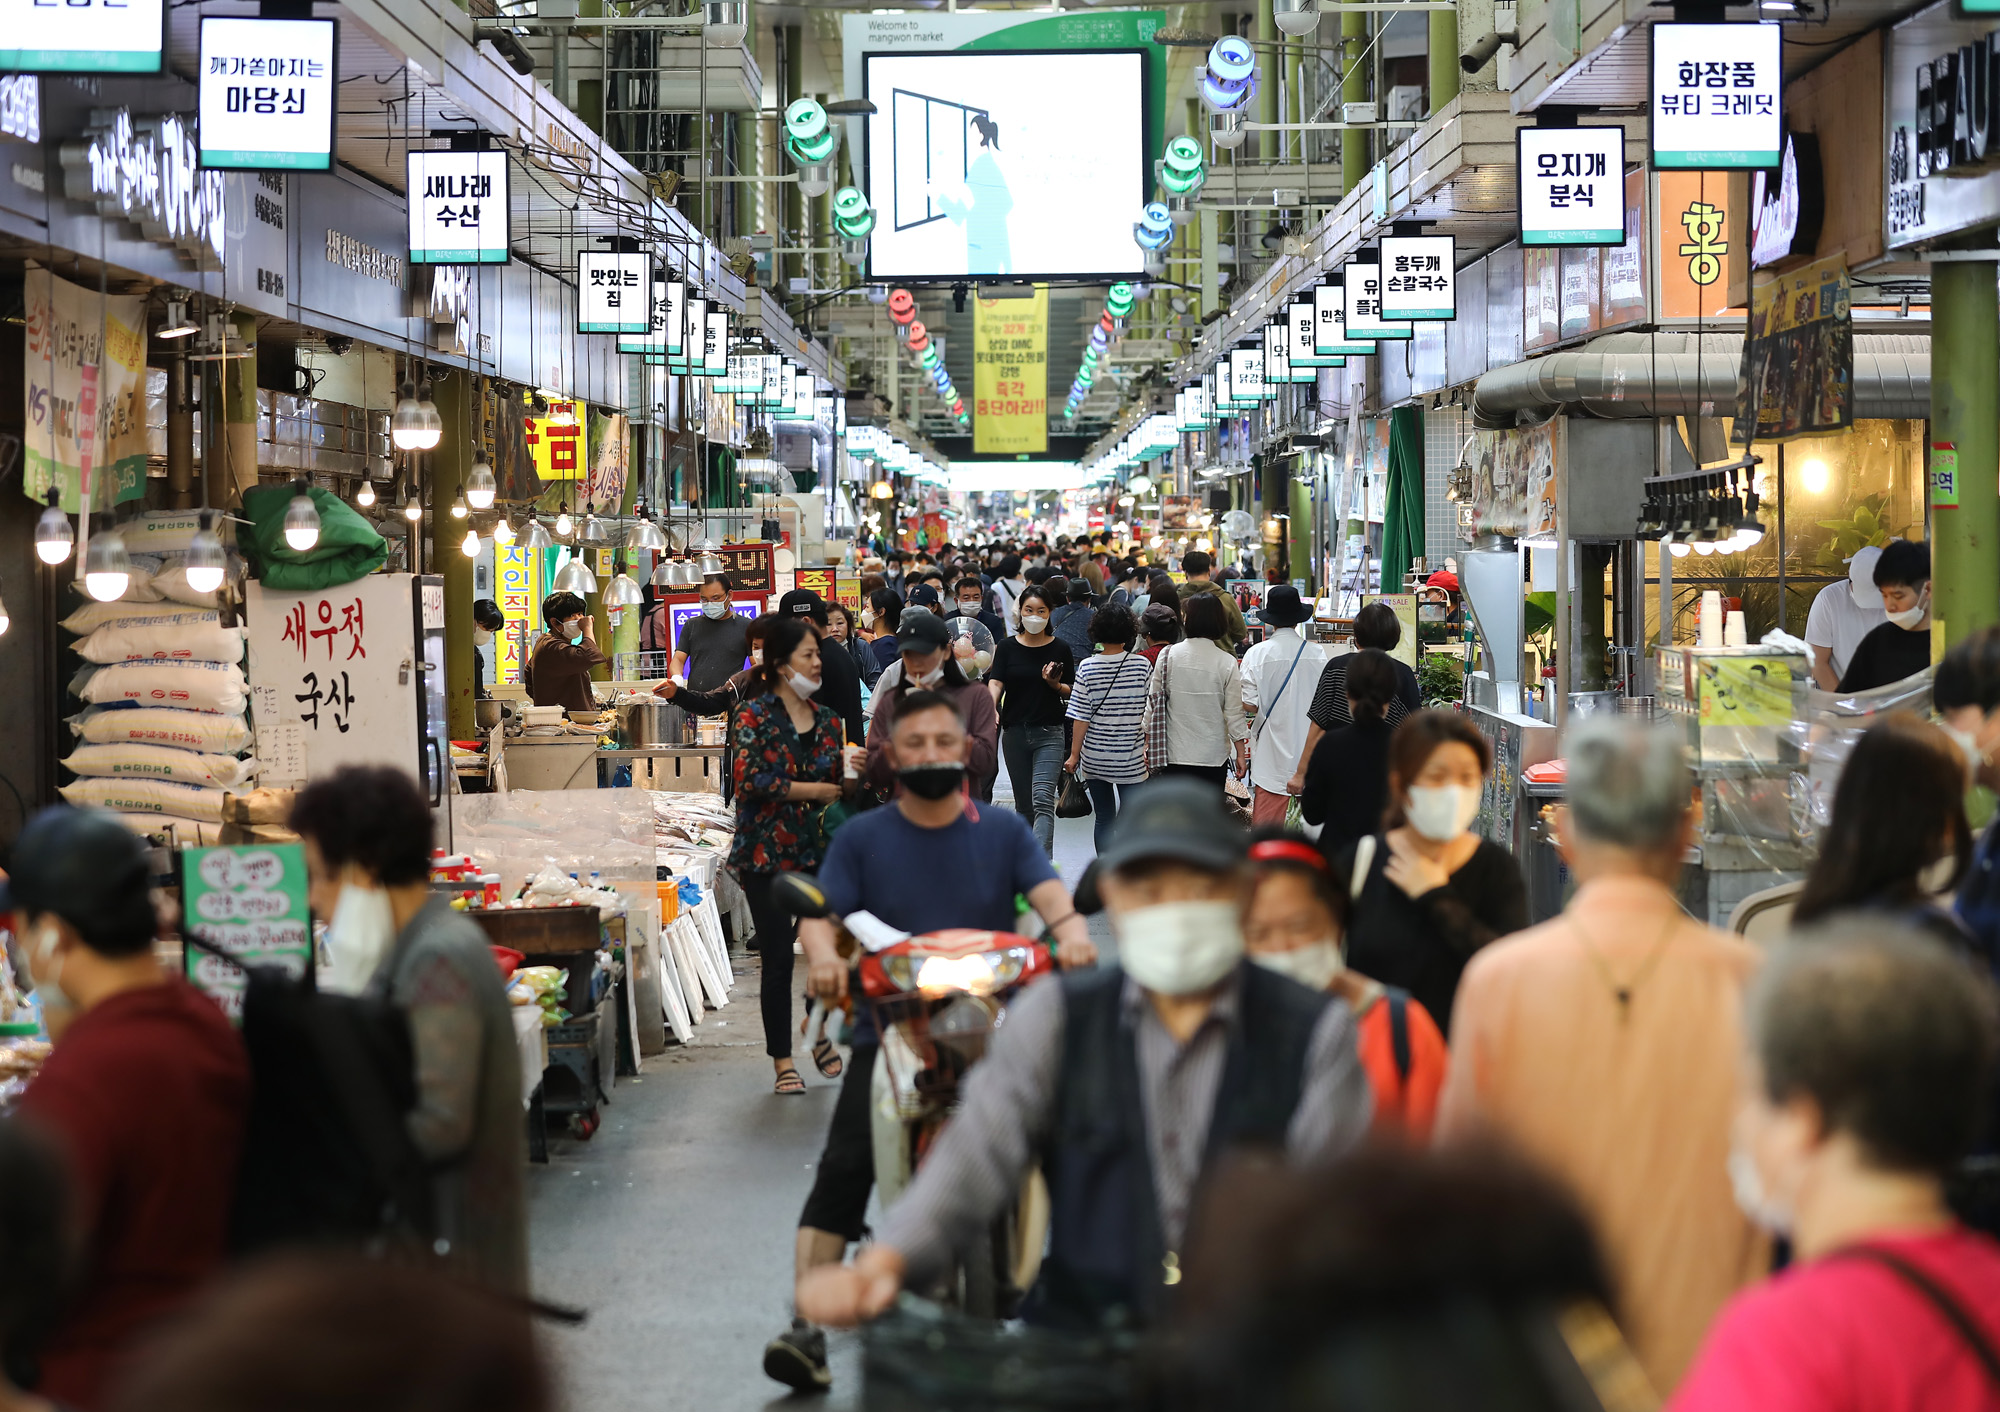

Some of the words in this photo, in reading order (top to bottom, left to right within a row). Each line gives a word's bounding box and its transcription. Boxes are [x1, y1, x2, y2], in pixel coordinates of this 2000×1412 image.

[868, 20, 907, 31] Welcome
[909, 21, 919, 30] to
[868, 33, 912, 45] mangwon
[914, 31, 944, 42] market
[210, 56, 323, 78] 깨가쏟아지는
[1679, 60, 1756, 88] 화장품
[227, 86, 306, 115] 마당쇠
[1661, 94, 1702, 116] 뷰티
[1711, 94, 1773, 116] 크레딧
[1537, 153, 1606, 178] 오지개
[424, 174, 491, 199] 새나래
[1549, 183, 1594, 208] 분식
[436, 204, 481, 228] 수산
[1679, 201, 1729, 285] 홍
[1394, 255, 1441, 272] 홍두깨
[590, 267, 639, 287] 맛있는
[1387, 275, 1448, 292] 손칼국수
[1363, 279, 1379, 296] 유
[606, 290, 621, 308] 집
[652, 314, 665, 332] 찬
[1300, 319, 1312, 332] 망
[1321, 309, 1345, 324] 민철
[1011, 338, 1033, 350] DMC
[1300, 335, 1313, 347] 튀
[728, 357, 758, 369] 원어묵
[996, 381, 1025, 397] 즉각
[976, 398, 1045, 417] 중단하라!!
[798, 570, 832, 602] 족
[1392, 598, 1409, 606] SALE
[281, 597, 367, 664] 새우젓
[295, 671, 355, 733] 국산
